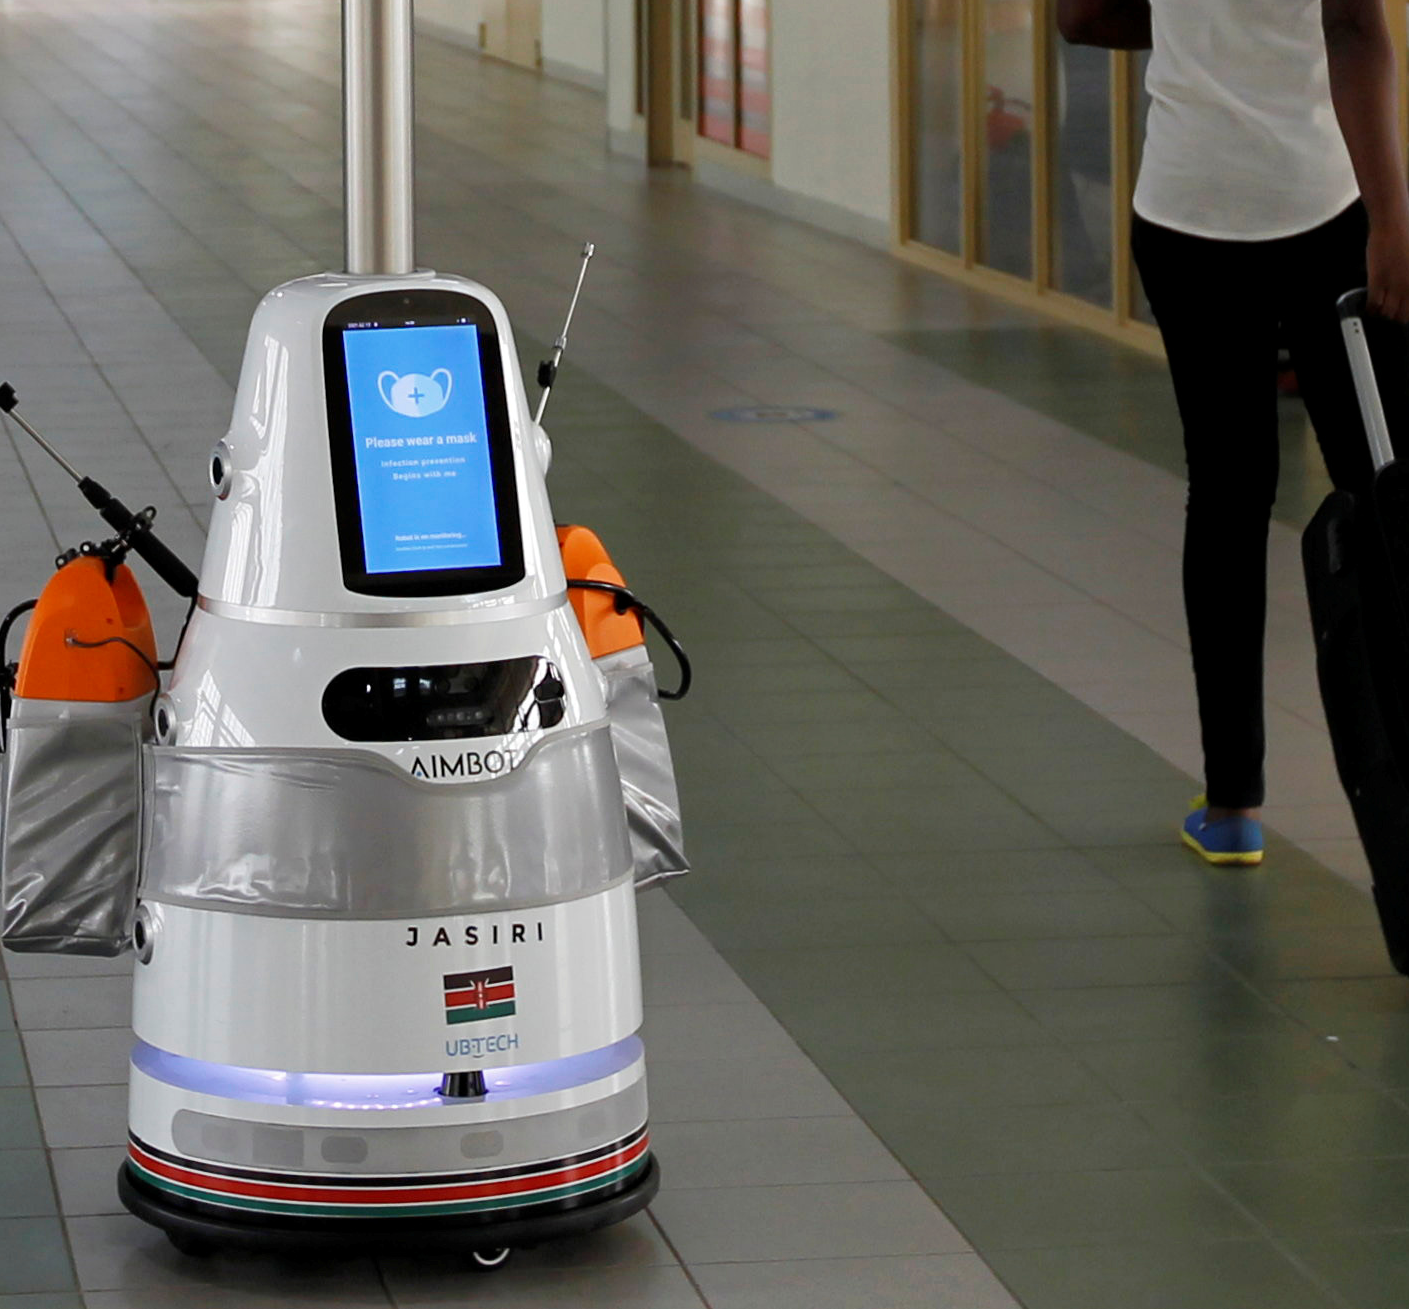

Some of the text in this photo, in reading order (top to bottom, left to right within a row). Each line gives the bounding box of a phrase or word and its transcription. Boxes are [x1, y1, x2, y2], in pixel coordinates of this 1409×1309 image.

[365, 432, 478, 449] Please wear a mask
[411, 749, 520, 779] AIMBOT
